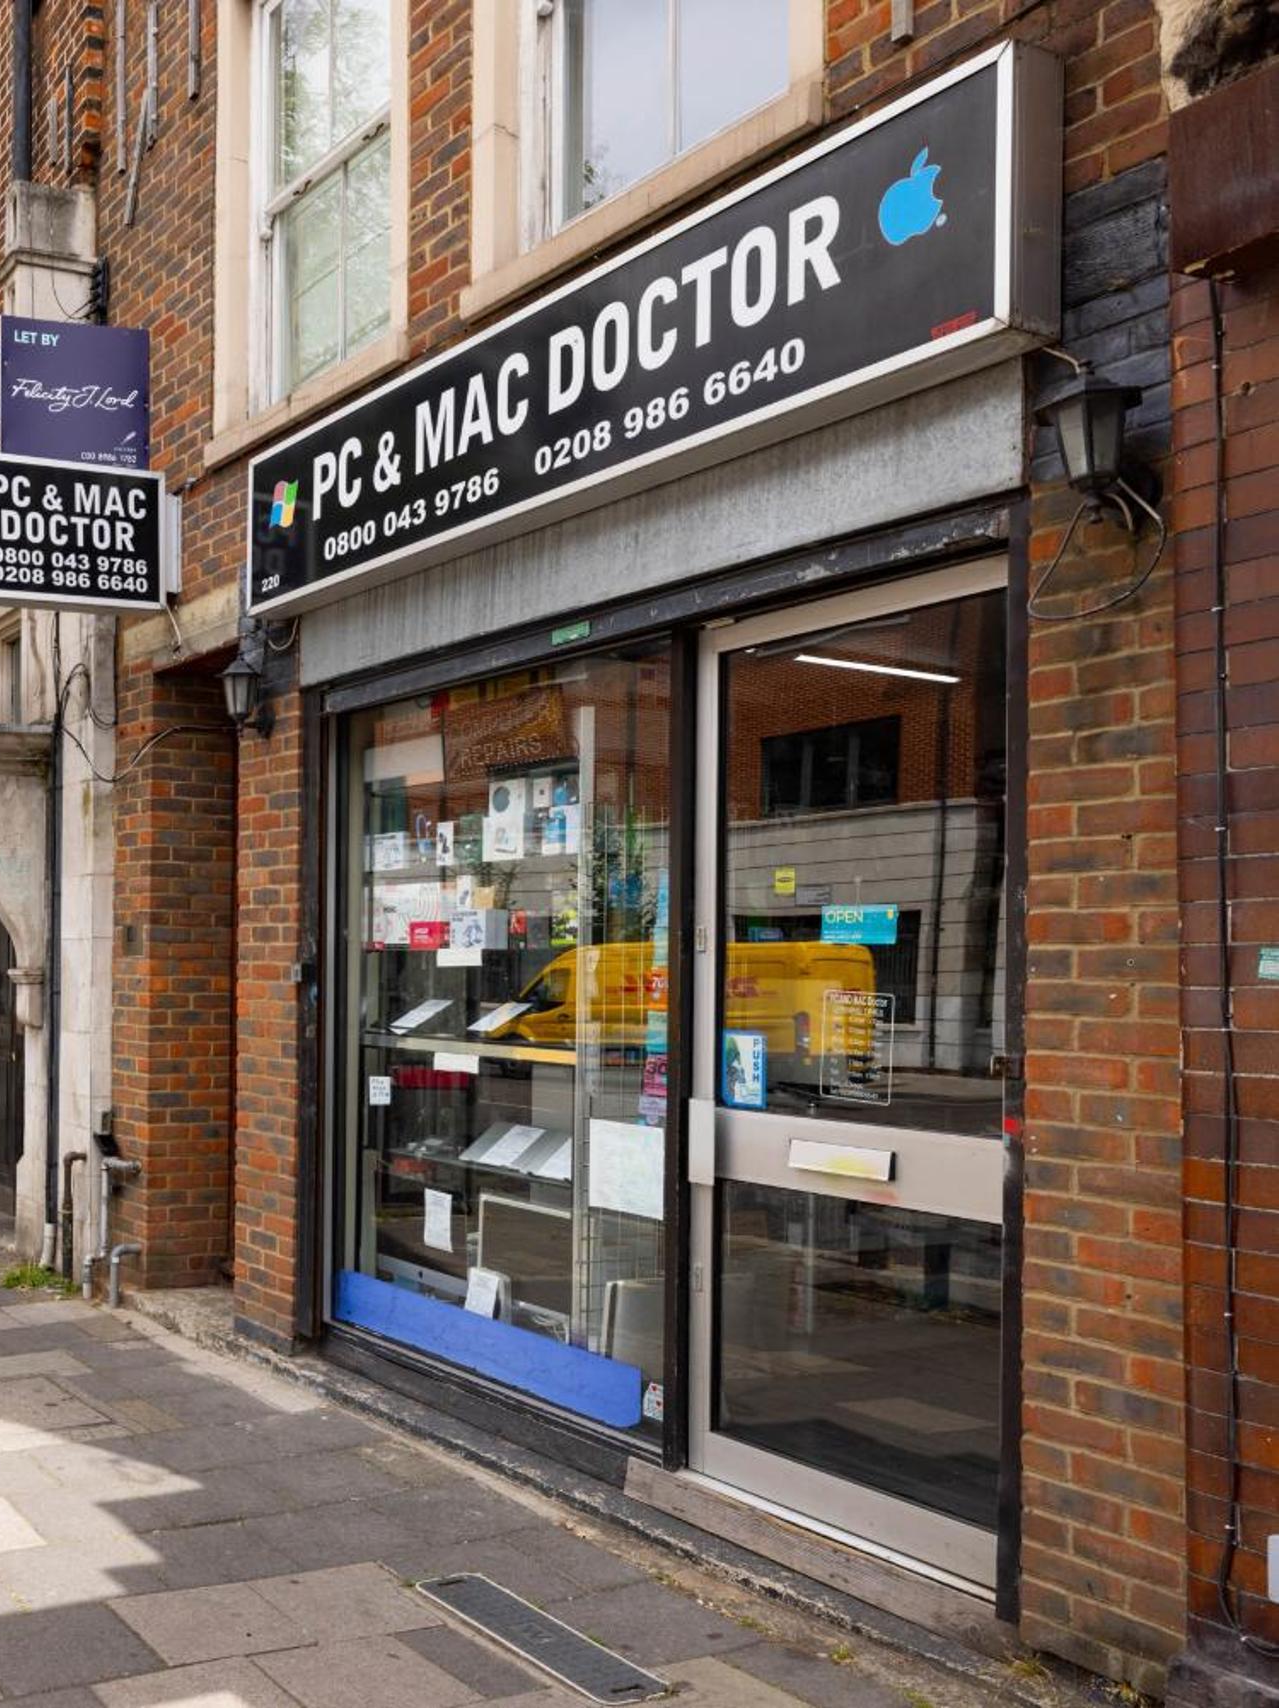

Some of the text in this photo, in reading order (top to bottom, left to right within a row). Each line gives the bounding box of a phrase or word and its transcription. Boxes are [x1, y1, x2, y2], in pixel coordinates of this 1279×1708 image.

[14, 330, 59, 346] LET BY
[312, 195, 842, 522] PC & MAC DOCTOR
[11, 378, 80, 412] Felicity
[324, 337, 806, 561] 0800 043 9786 0208 986 6640
[41, 484, 63, 512] &
[74, 482, 147, 520] MAC
[0, 508, 135, 552] DOCTOR
[51, 551, 90, 570] 043
[96, 555, 148, 575] 9786
[51, 569, 91, 588] 986
[97, 574, 148, 593] 6640
[261, 574, 281, 593] 220
[825, 910, 863, 924] OPEN
[752, 1037, 761, 1083] PUSH
